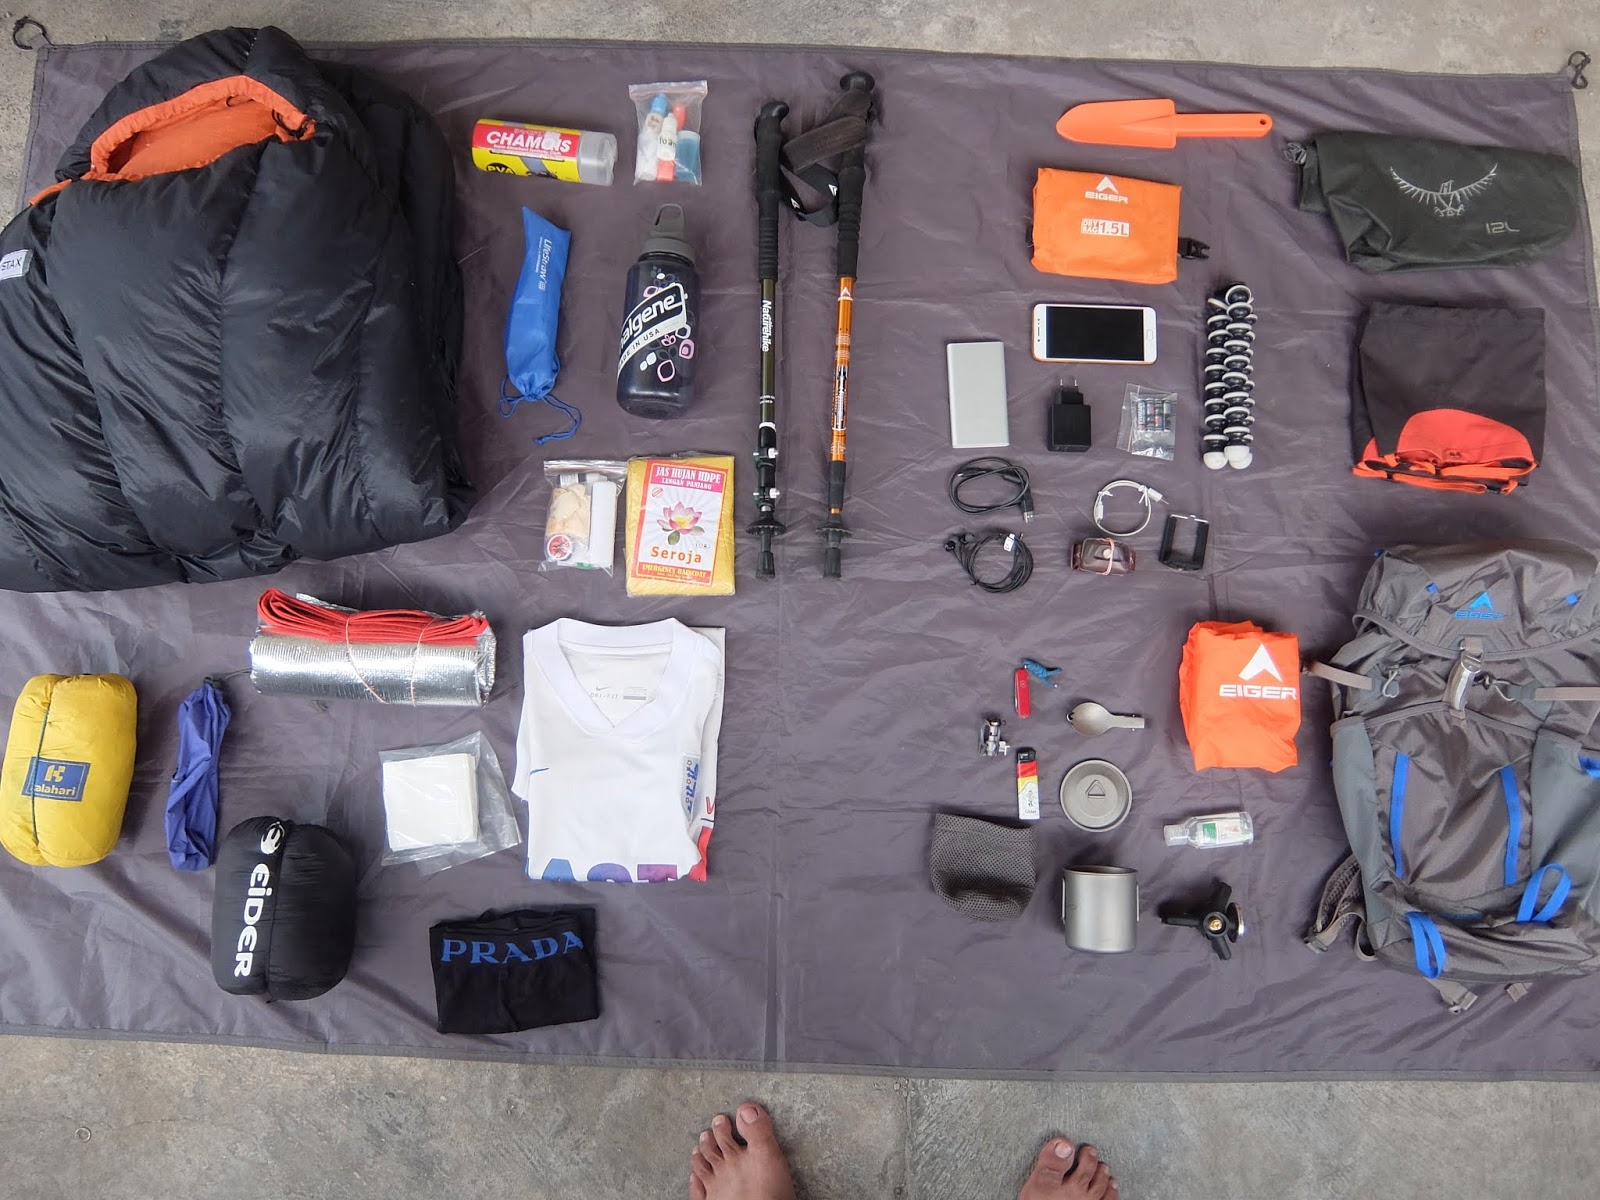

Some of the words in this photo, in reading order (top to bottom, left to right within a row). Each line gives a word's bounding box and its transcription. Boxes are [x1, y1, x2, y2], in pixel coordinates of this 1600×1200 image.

[1085, 191, 1129, 204] EIGER
[1100, 221, 1128, 236] 1.5L
[1486, 221, 1520, 234] 12L
[539, 239, 552, 284] LifeStraw
[762, 300, 773, 352] Naturehike
[632, 340, 641, 350] IN
[643, 328, 661, 341] USA
[656, 466, 670, 477] JAS
[671, 468, 697, 480] HUJAN
[698, 470, 722, 484] HDPE
[662, 477, 684, 486] LENGAN
[686, 480, 712, 490] PANJANG
[651, 546, 702, 565] Seroja
[642, 564, 676, 574] EMERGENCY
[677, 569, 707, 578] RAINCOAT
[1219, 684, 1297, 700] EIGER
[32, 783, 76, 796] alahari
[441, 931, 584, 964] PRADA
